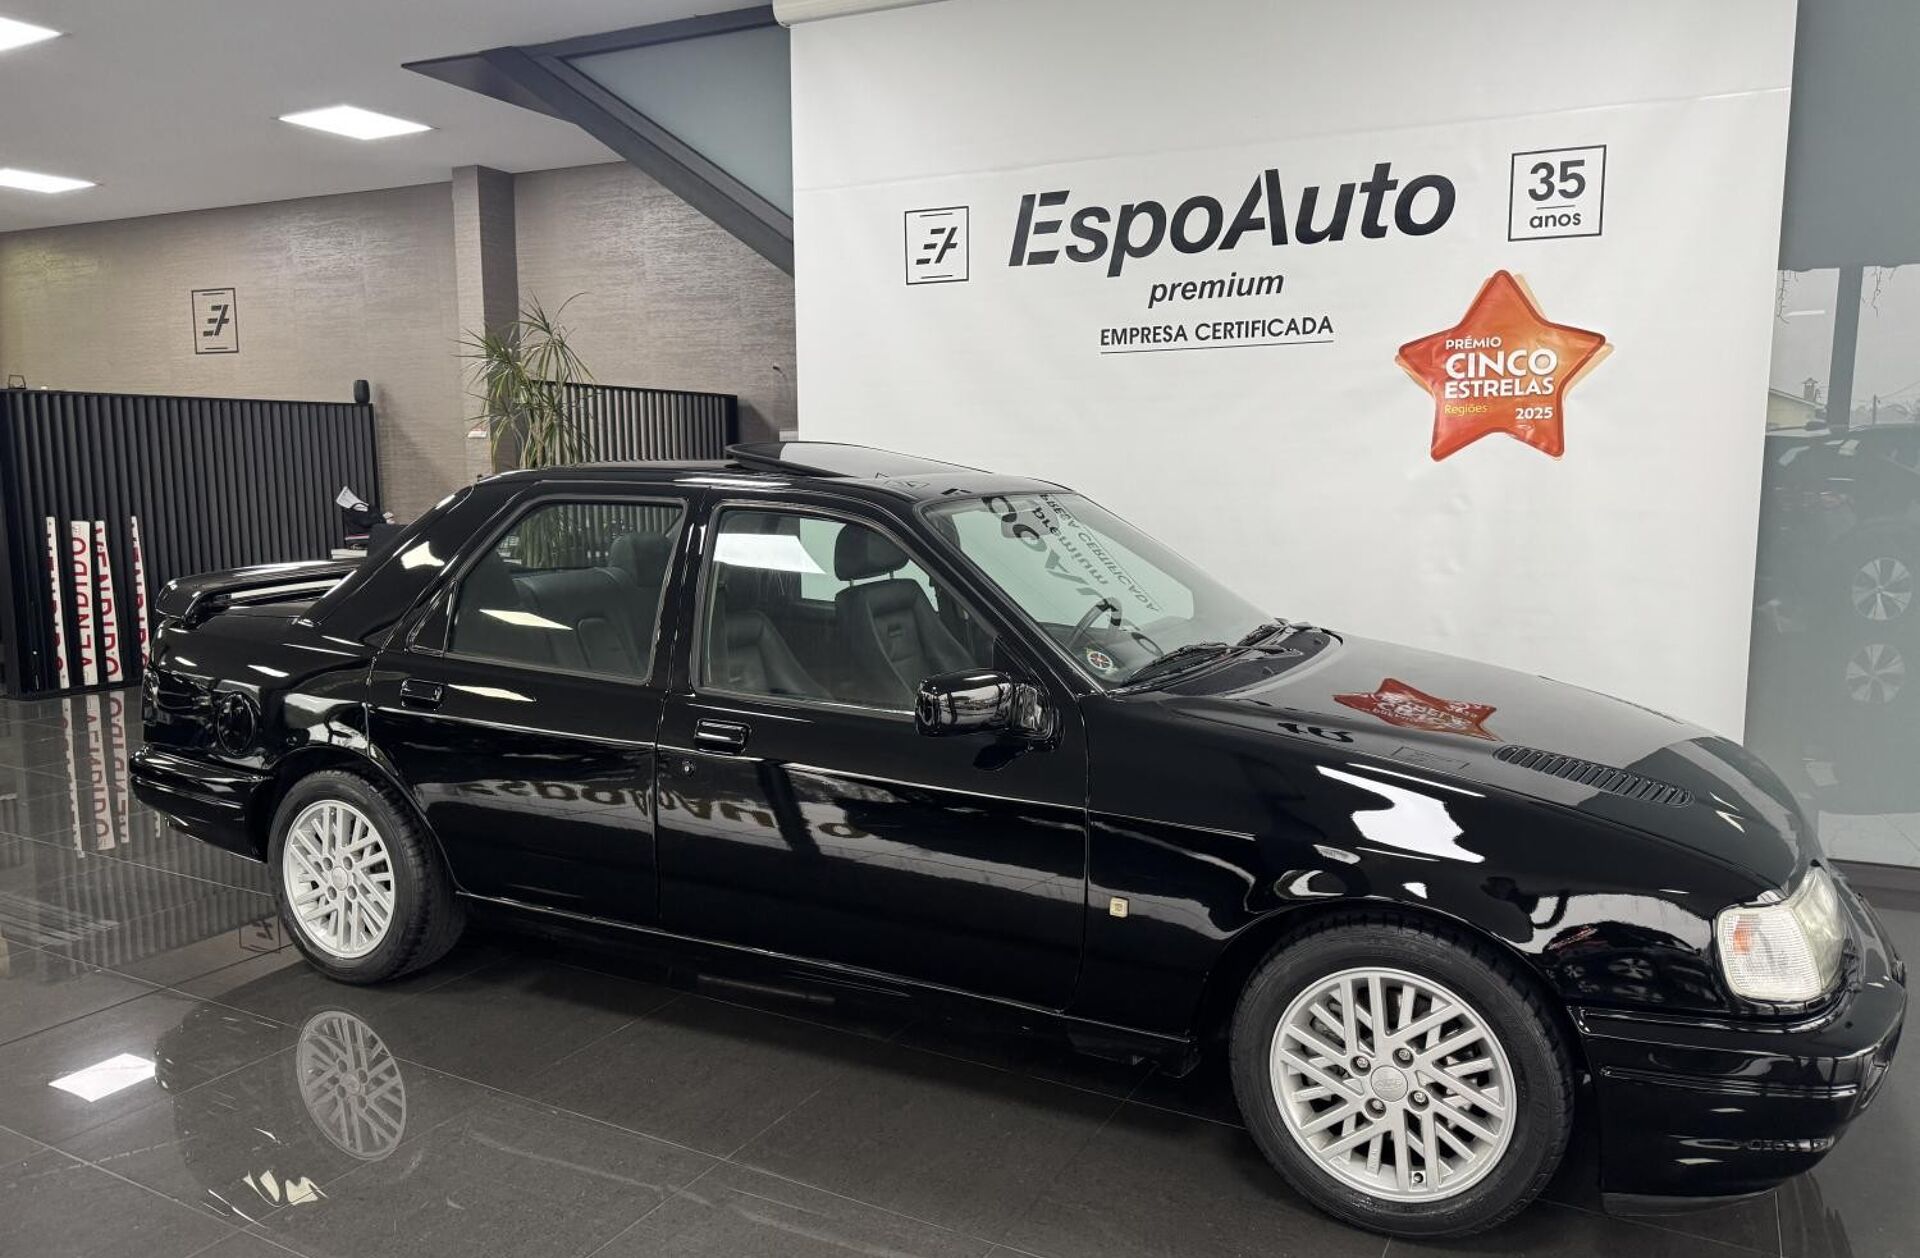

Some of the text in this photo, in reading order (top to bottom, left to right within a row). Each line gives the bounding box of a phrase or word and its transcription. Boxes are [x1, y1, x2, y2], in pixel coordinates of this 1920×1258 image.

[1527, 159, 1586, 202] 35
[1008, 161, 1456, 278] EspoAuto
[1529, 211, 1582, 229] anos
[1147, 271, 1285, 309] premium
[1100, 315, 1334, 346] EMPRESA CERTIFICADA
[1445, 335, 1503, 350] PRÉMIO
[1445, 347, 1559, 380] CINCO
[1444, 377, 1555, 400] ESTRELAS
[1444, 403, 1489, 417] Regiões
[1515, 406, 1554, 421] 2025
